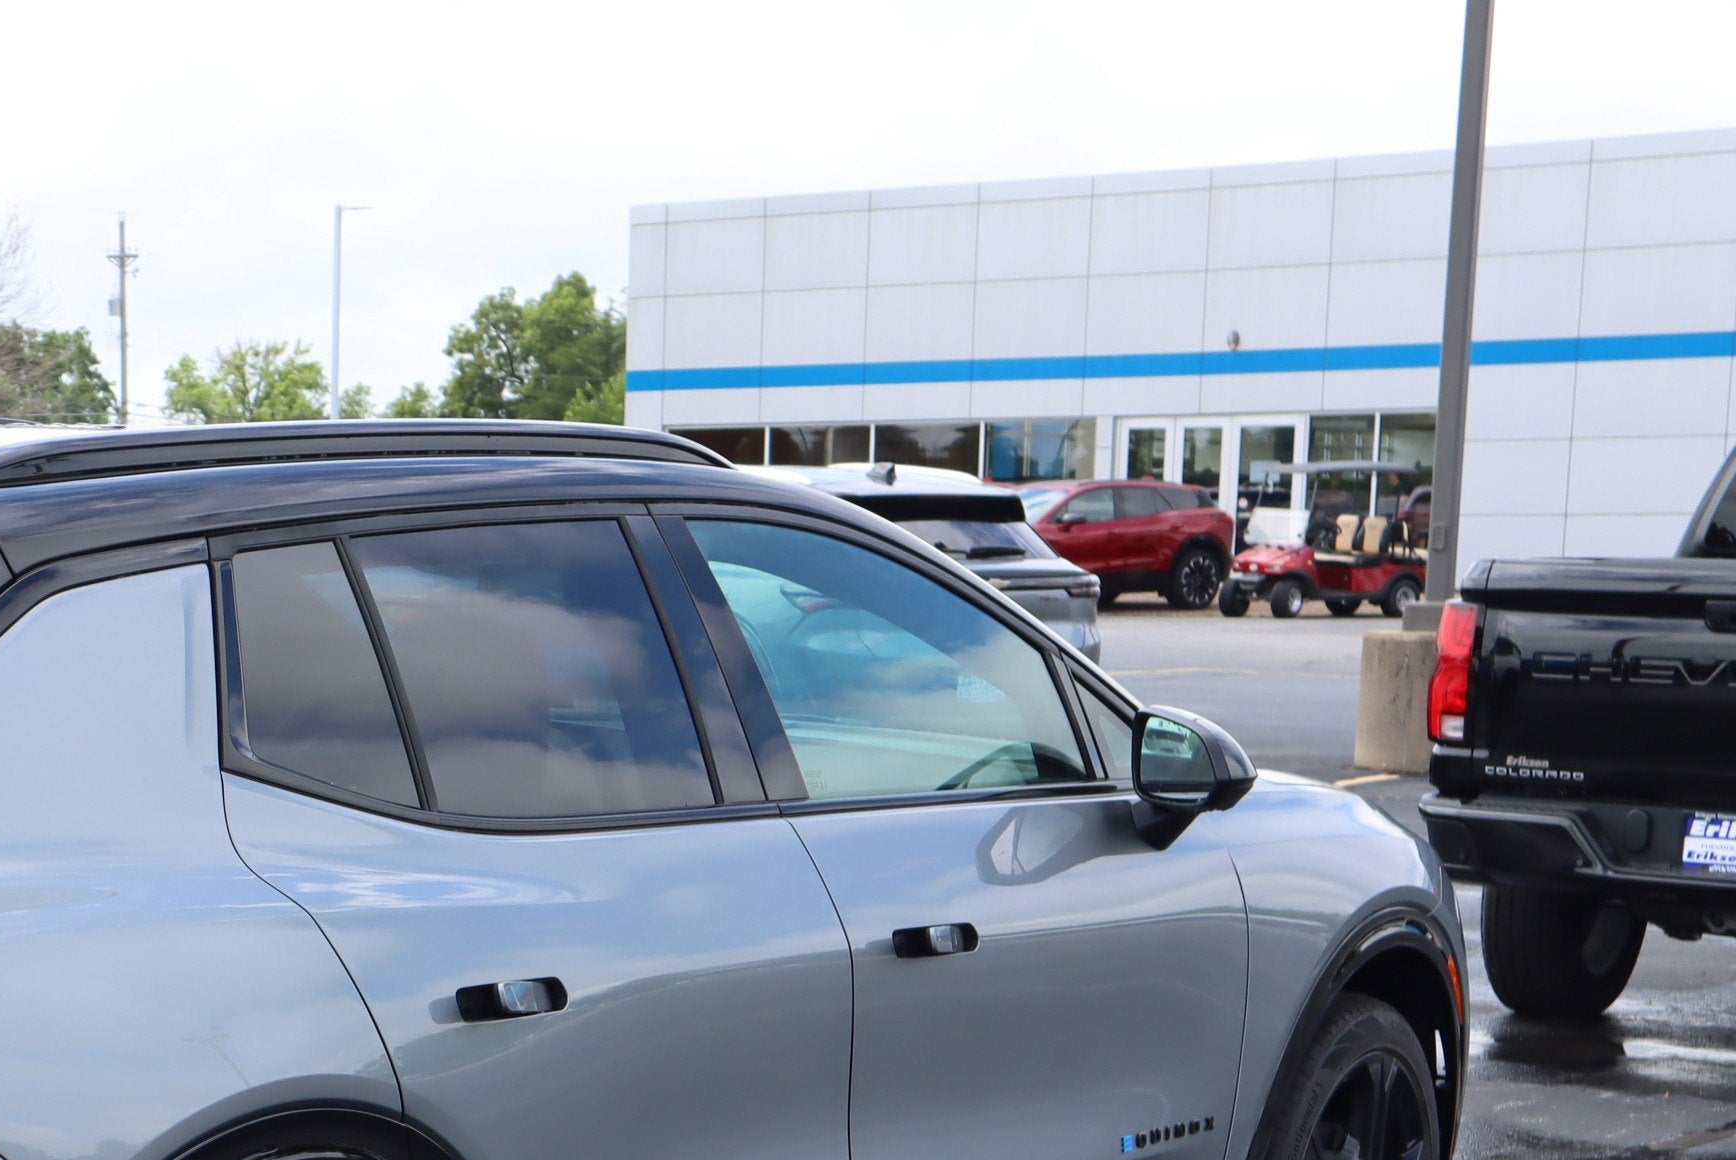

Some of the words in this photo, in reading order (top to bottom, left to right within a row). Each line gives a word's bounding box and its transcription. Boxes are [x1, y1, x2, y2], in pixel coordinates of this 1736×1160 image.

[1530, 651, 1736, 687] CHEV
[1484, 765, 1585, 781] COLORADO
[1121, 1116, 1214, 1154] EQUINOX
